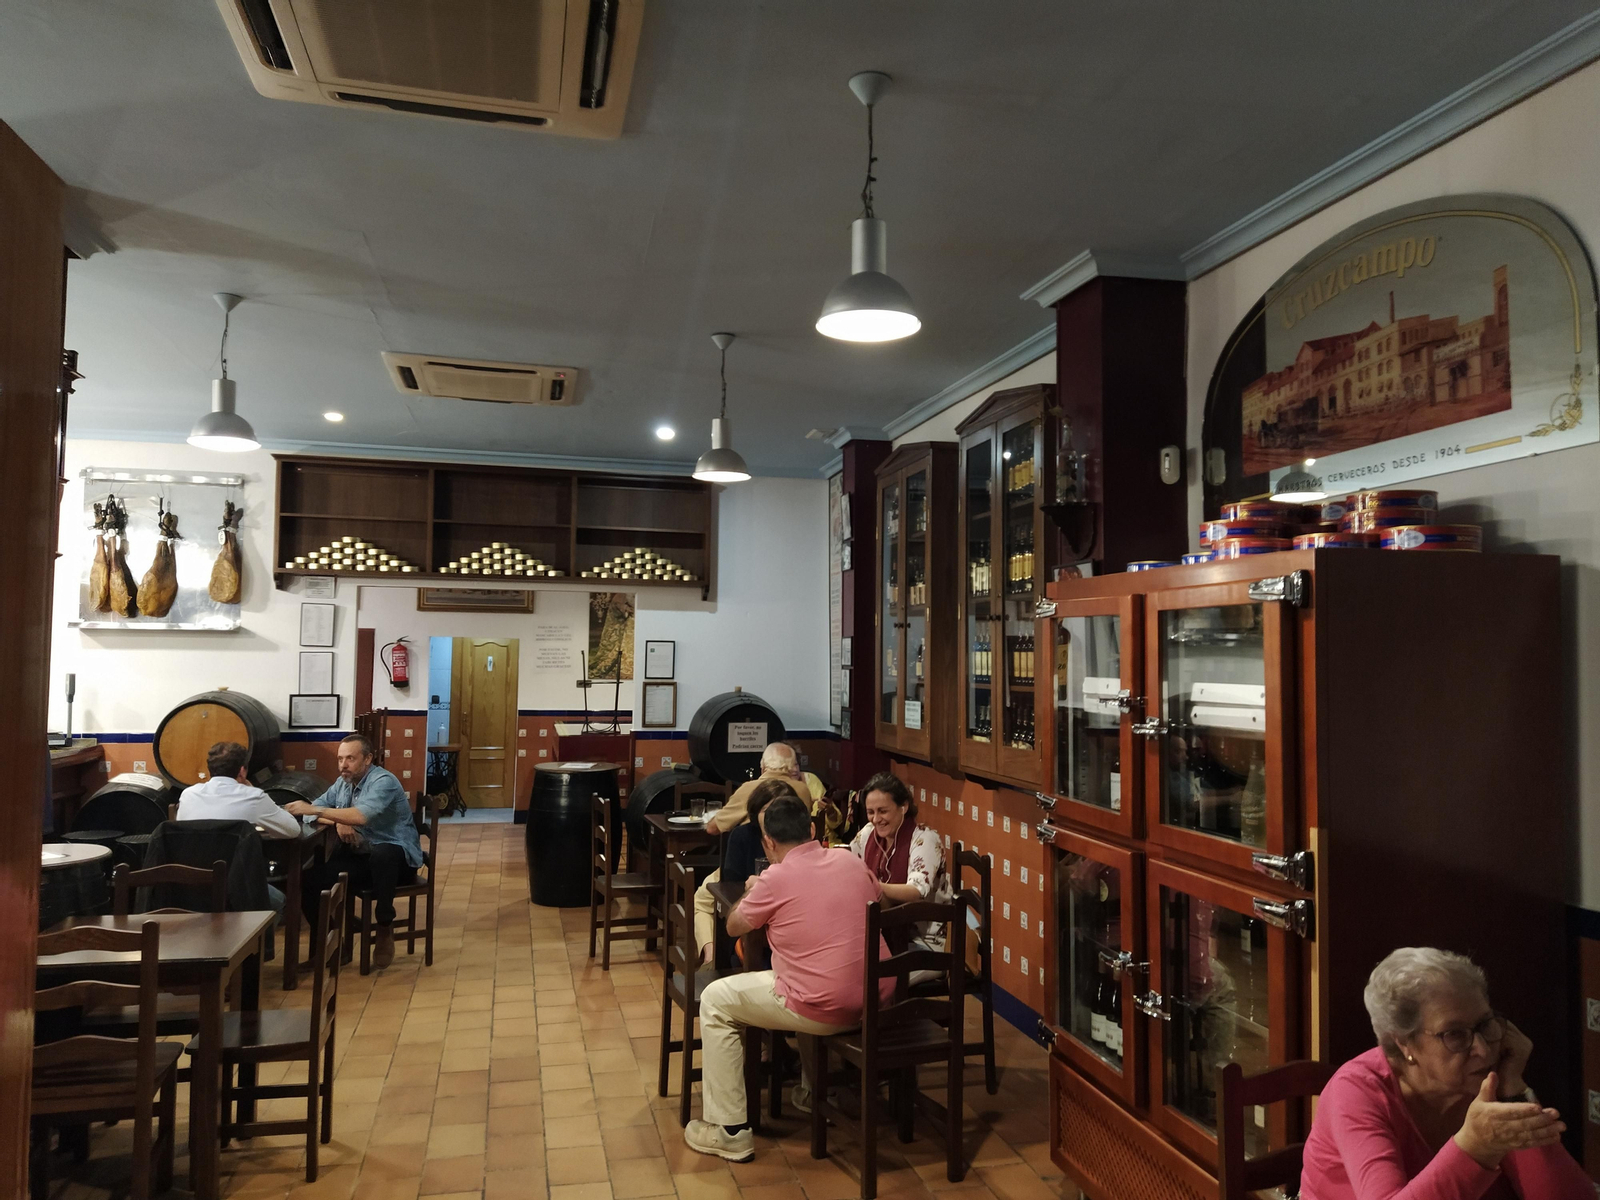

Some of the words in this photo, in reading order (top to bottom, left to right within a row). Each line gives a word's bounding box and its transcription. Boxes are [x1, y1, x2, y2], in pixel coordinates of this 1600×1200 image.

[1280, 235, 1436, 330] Cruzcampo
[1327, 462, 1386, 483] CERVECEROS
[1392, 453, 1426, 470] DESDE
[1434, 444, 1462, 460] 1904
